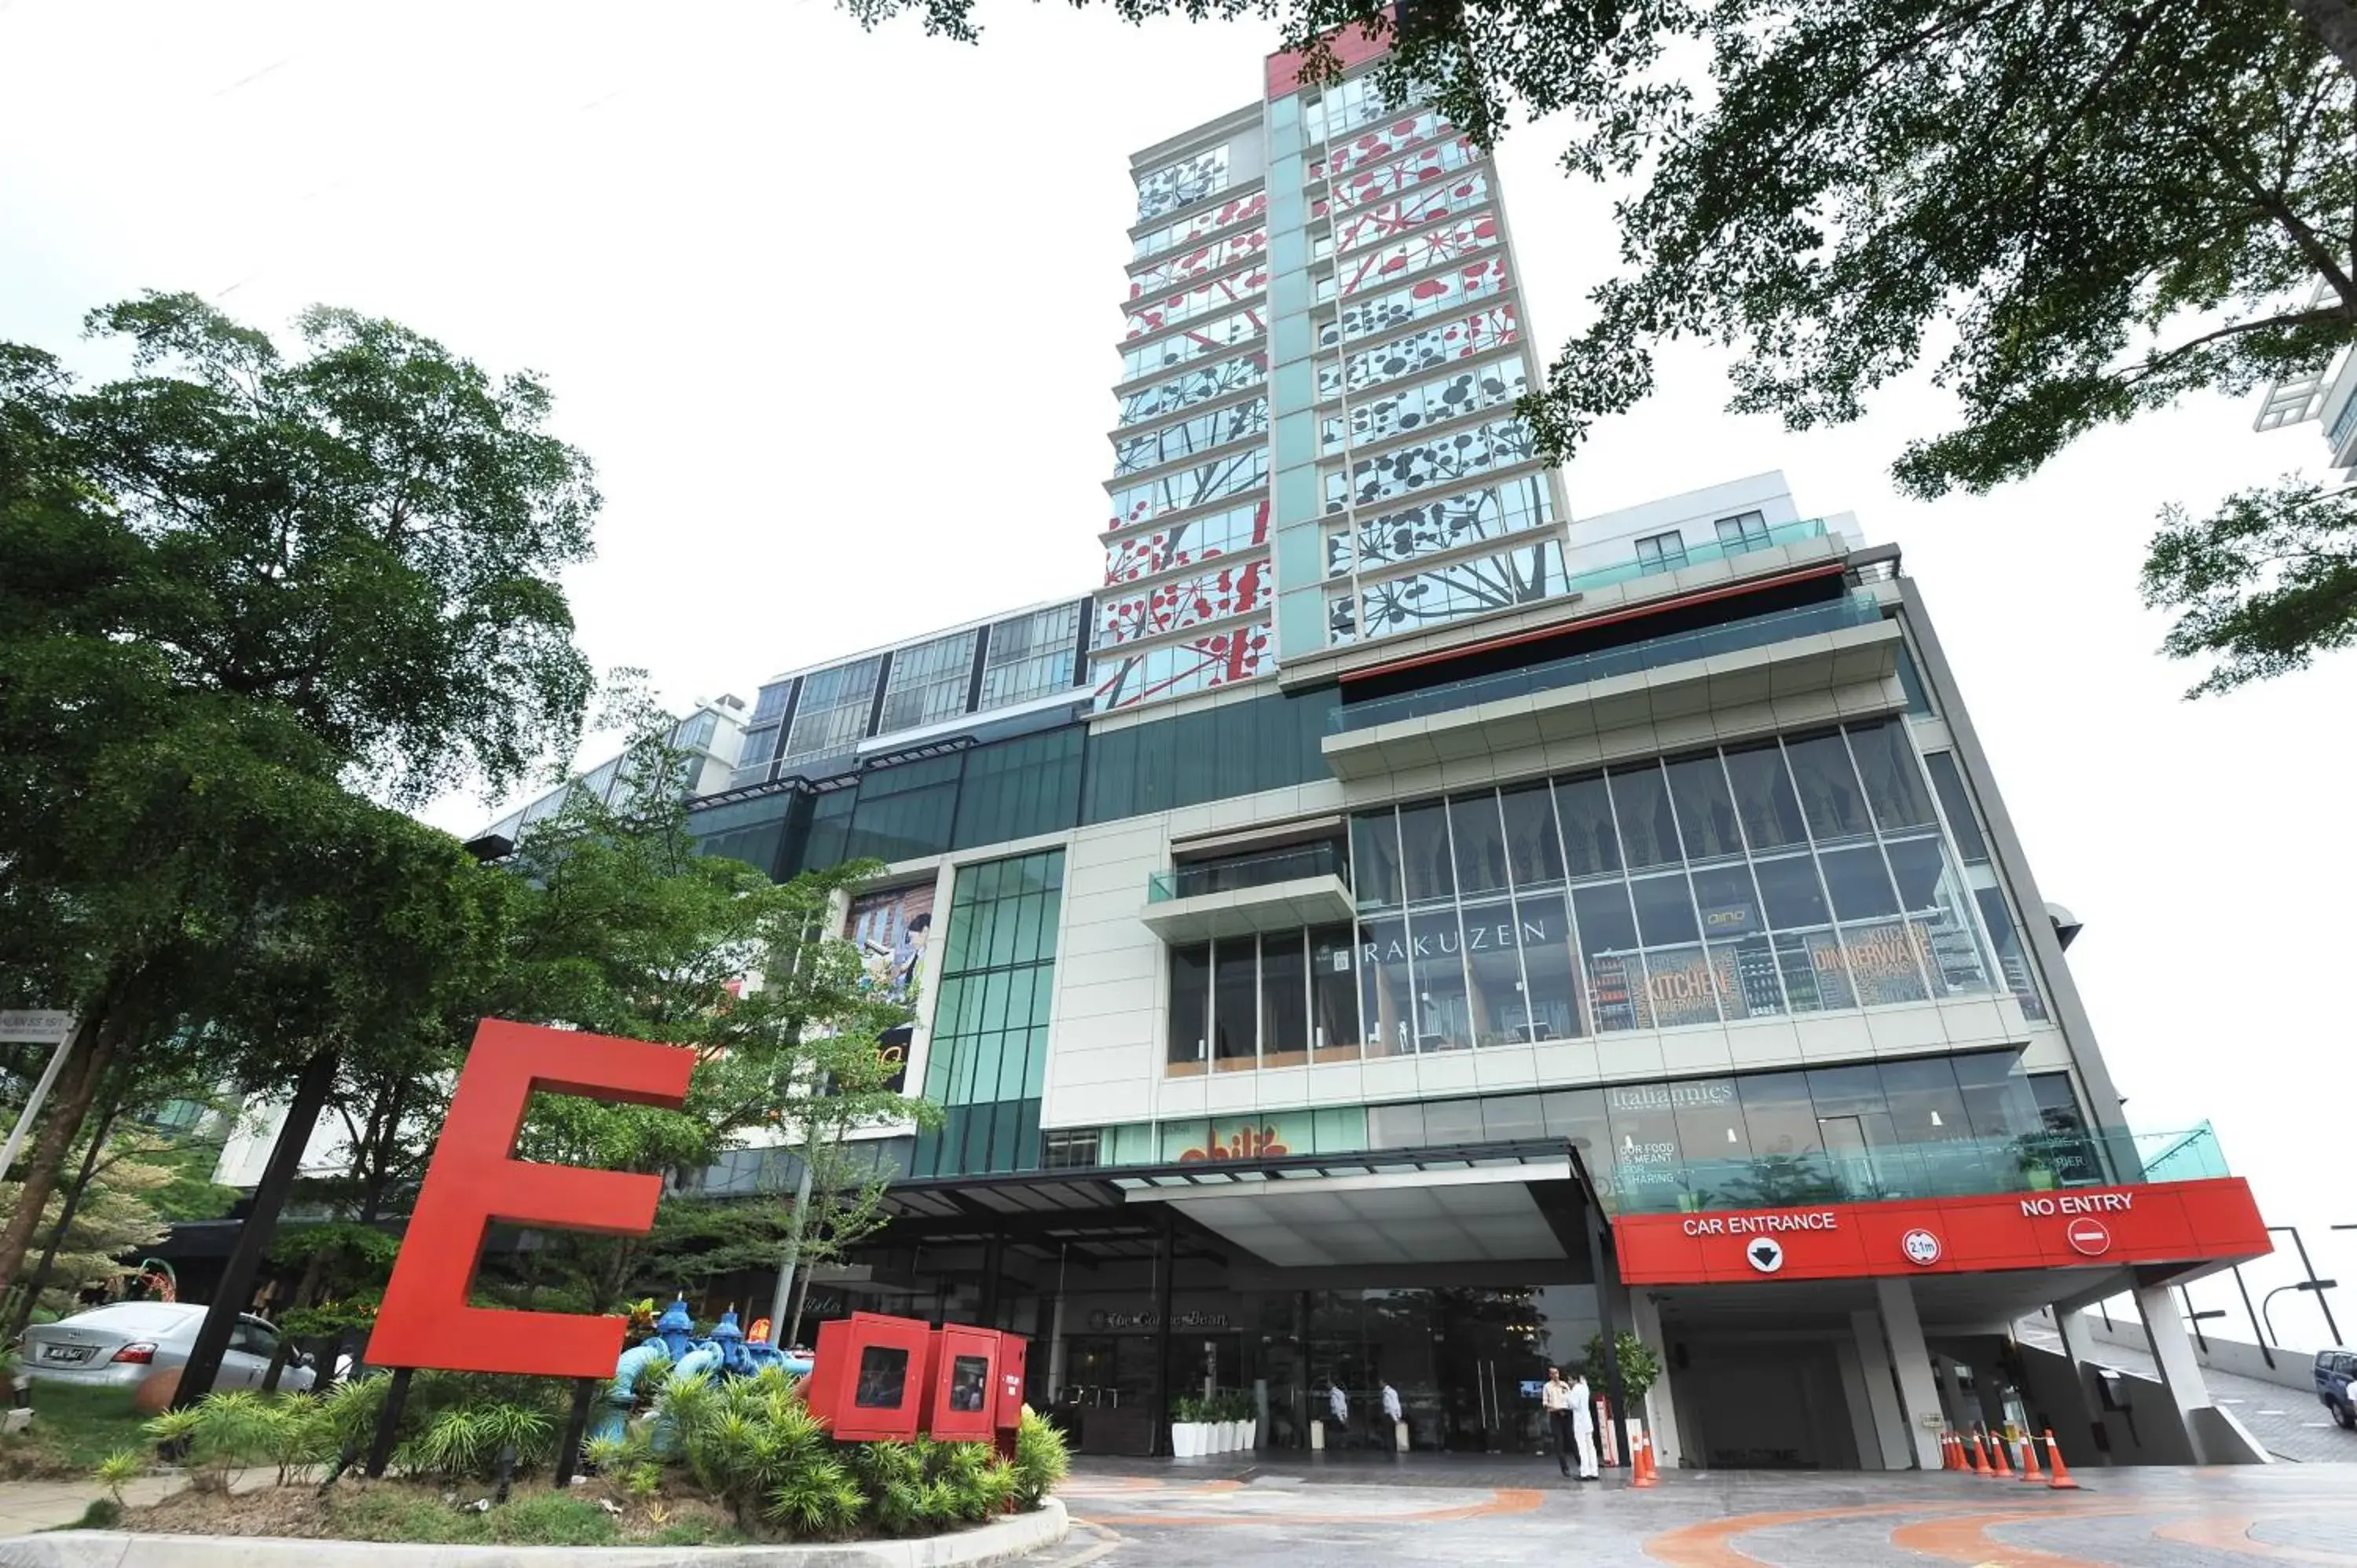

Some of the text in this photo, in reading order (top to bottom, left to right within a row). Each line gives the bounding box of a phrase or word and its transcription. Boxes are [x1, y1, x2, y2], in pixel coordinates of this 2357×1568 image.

[1365, 920, 1546, 963] RAKUZEN
[1645, 969, 1731, 1001] KITCHEN
[1620, 1143, 1674, 1155] OUR FOOD
[1622, 1153, 1673, 1165] IS MEANT
[1628, 1174, 1674, 1185] HARING
[363, 1017, 696, 1379] E
[2020, 1192, 2133, 1217] NO ENTRY
[1684, 1212, 1838, 1236] CAR ENTRANCE
[1910, 1241, 1935, 1254] 2.1m
